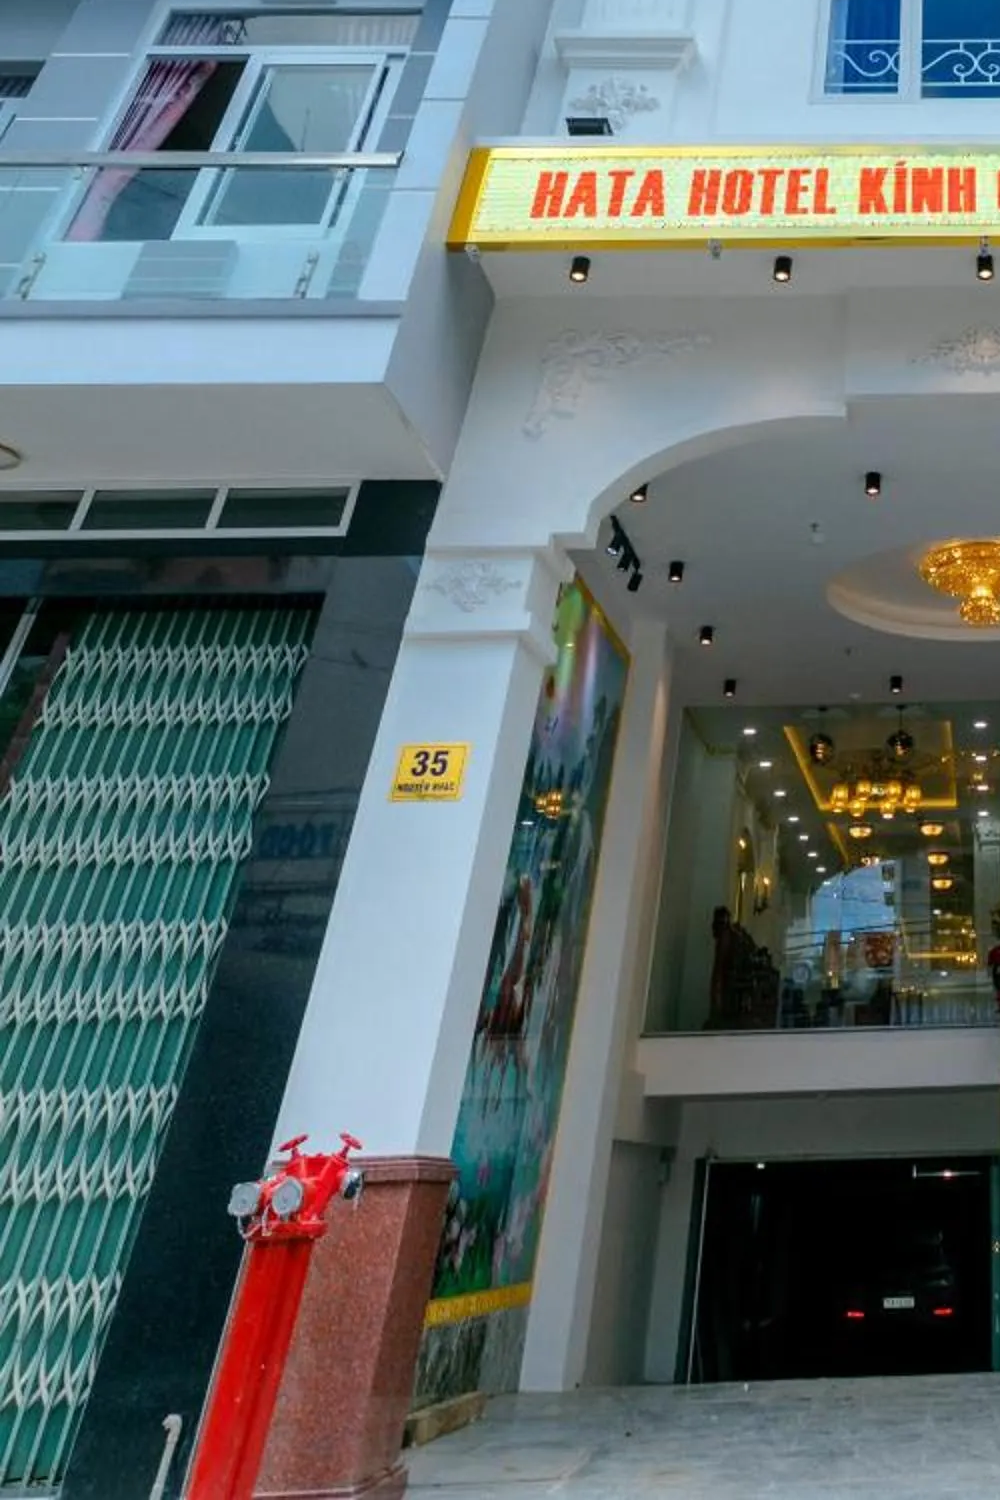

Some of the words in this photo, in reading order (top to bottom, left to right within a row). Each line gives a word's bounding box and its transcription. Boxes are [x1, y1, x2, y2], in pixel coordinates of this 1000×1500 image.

[530, 170, 665, 219] HATA
[687, 168, 836, 217] HOTEL
[858, 161, 977, 214] KÍNH
[411, 750, 449, 777] 35
